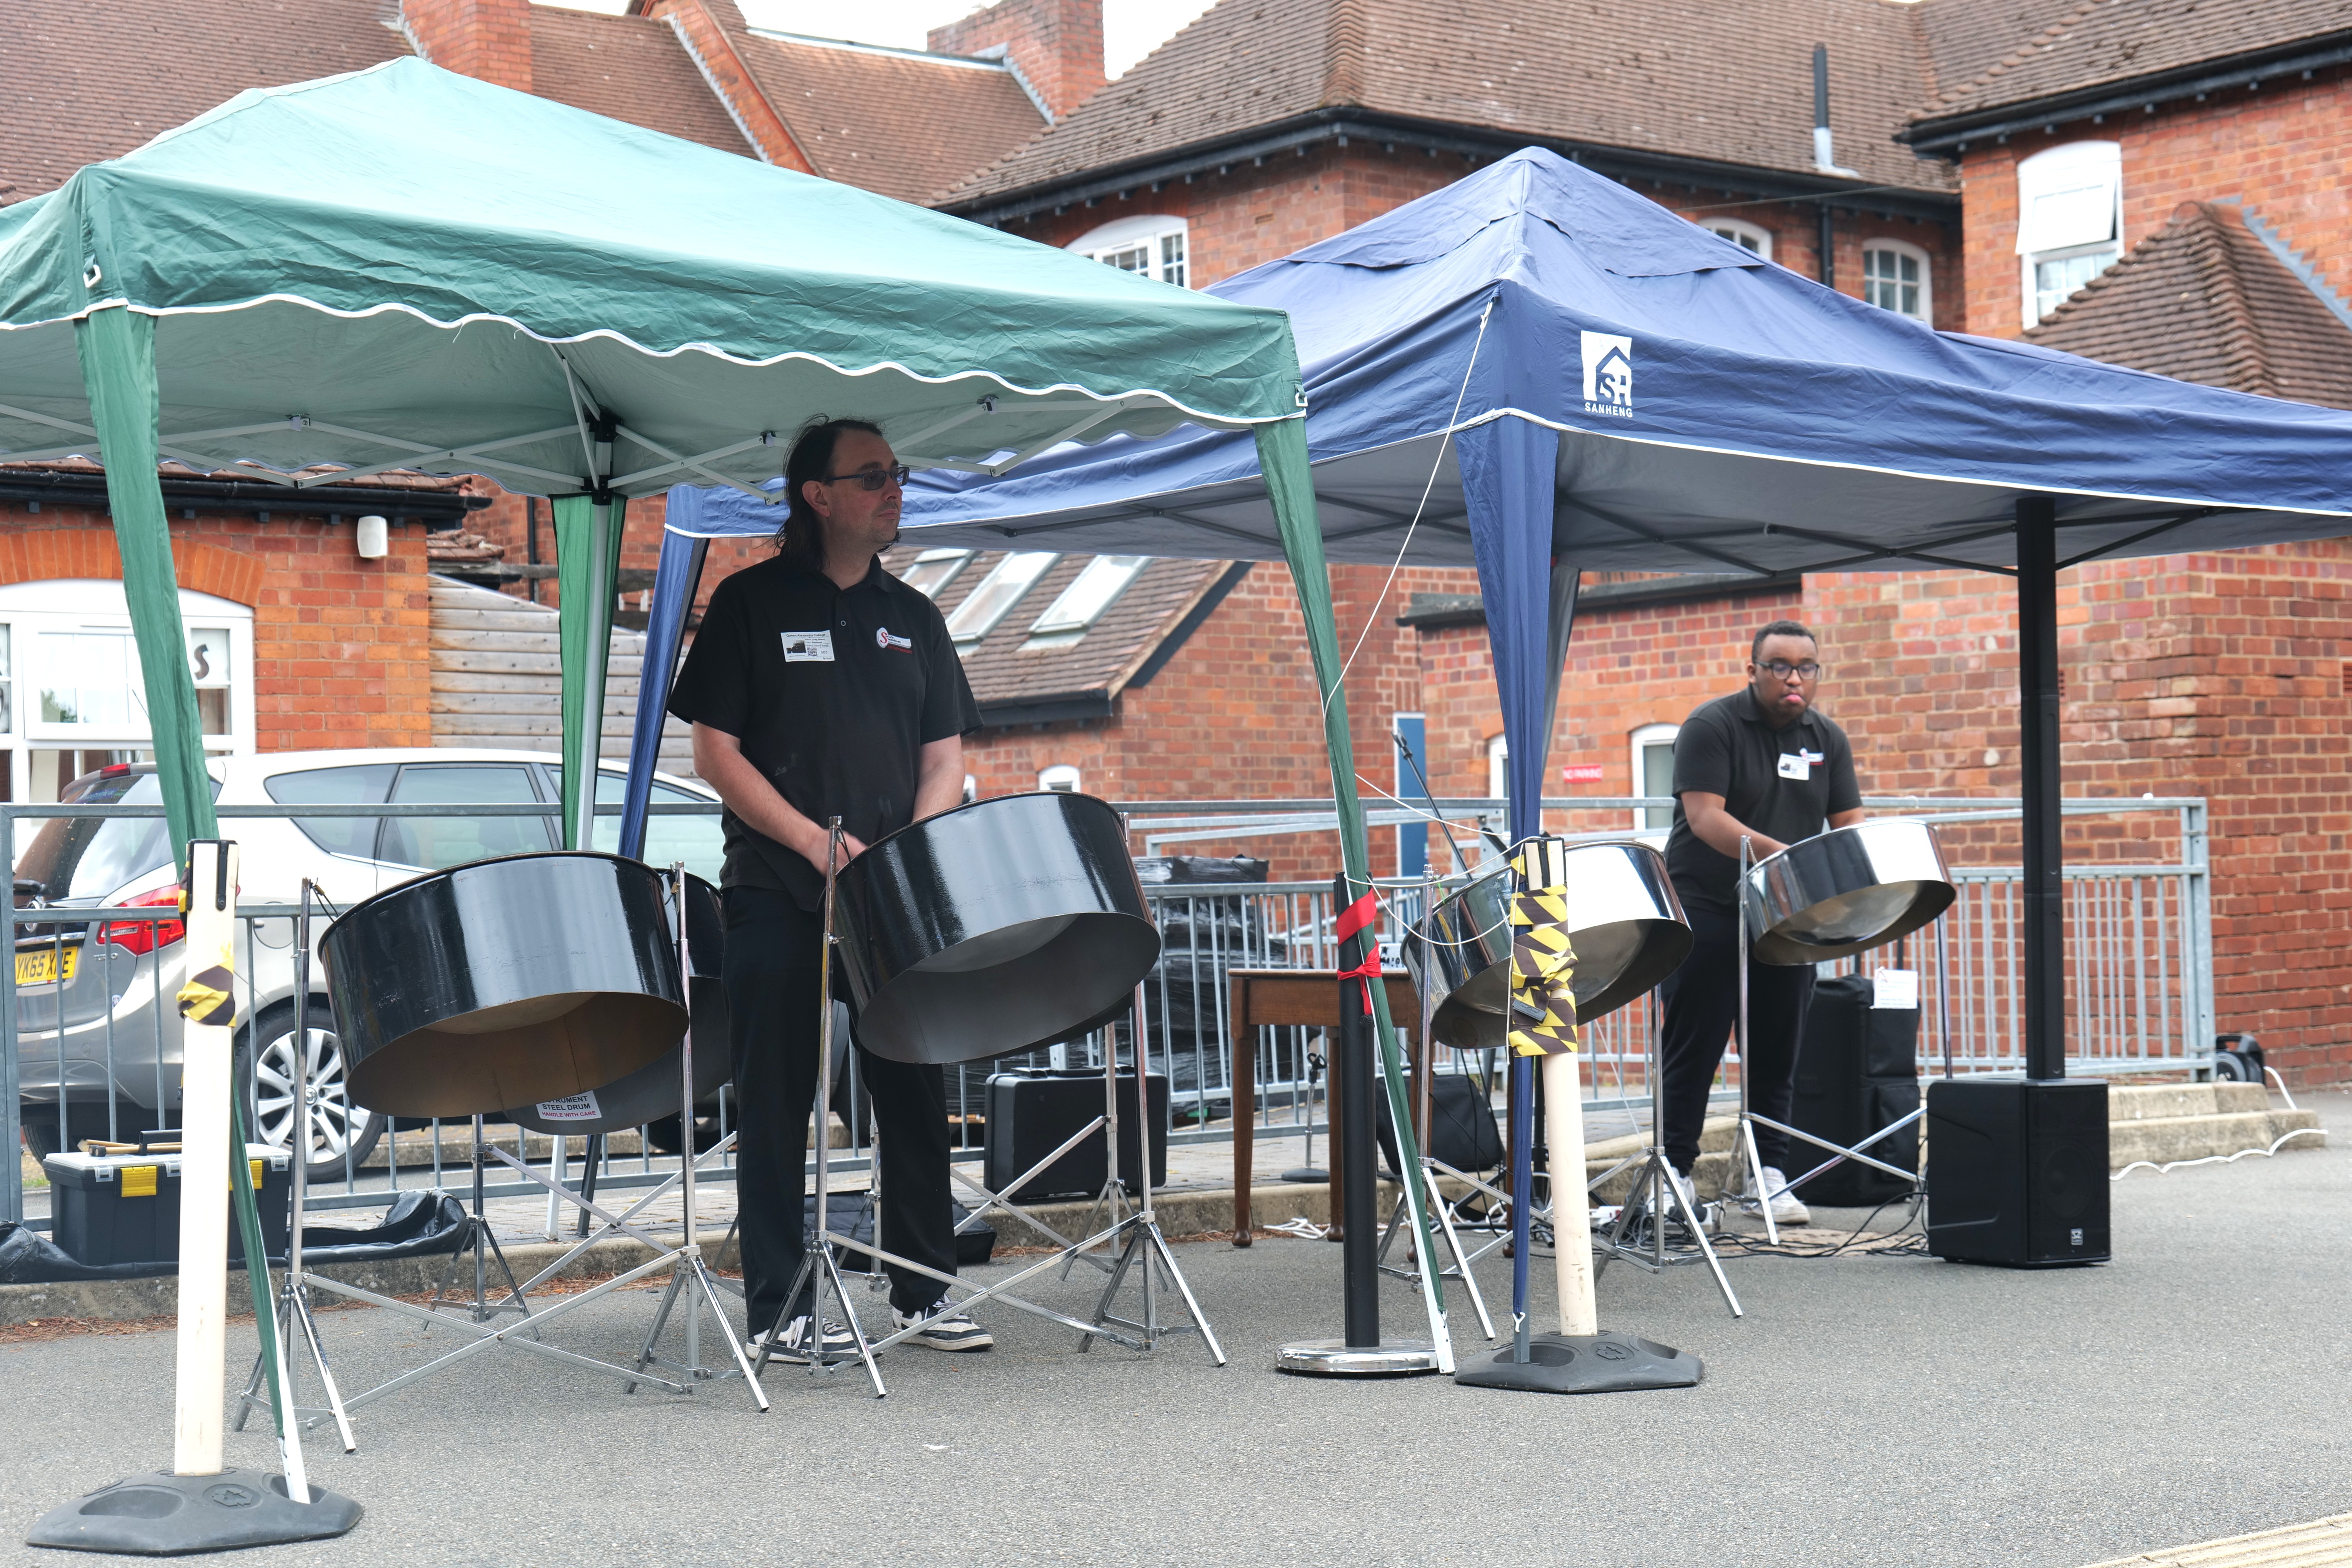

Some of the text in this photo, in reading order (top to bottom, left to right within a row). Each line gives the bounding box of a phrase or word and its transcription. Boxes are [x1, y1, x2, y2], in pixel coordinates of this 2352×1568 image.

[1585, 402, 1633, 418] SANHENG
[193, 644, 209, 680] S
[1563, 769, 1573, 779] NO
[17, 954, 45, 980] YK65
